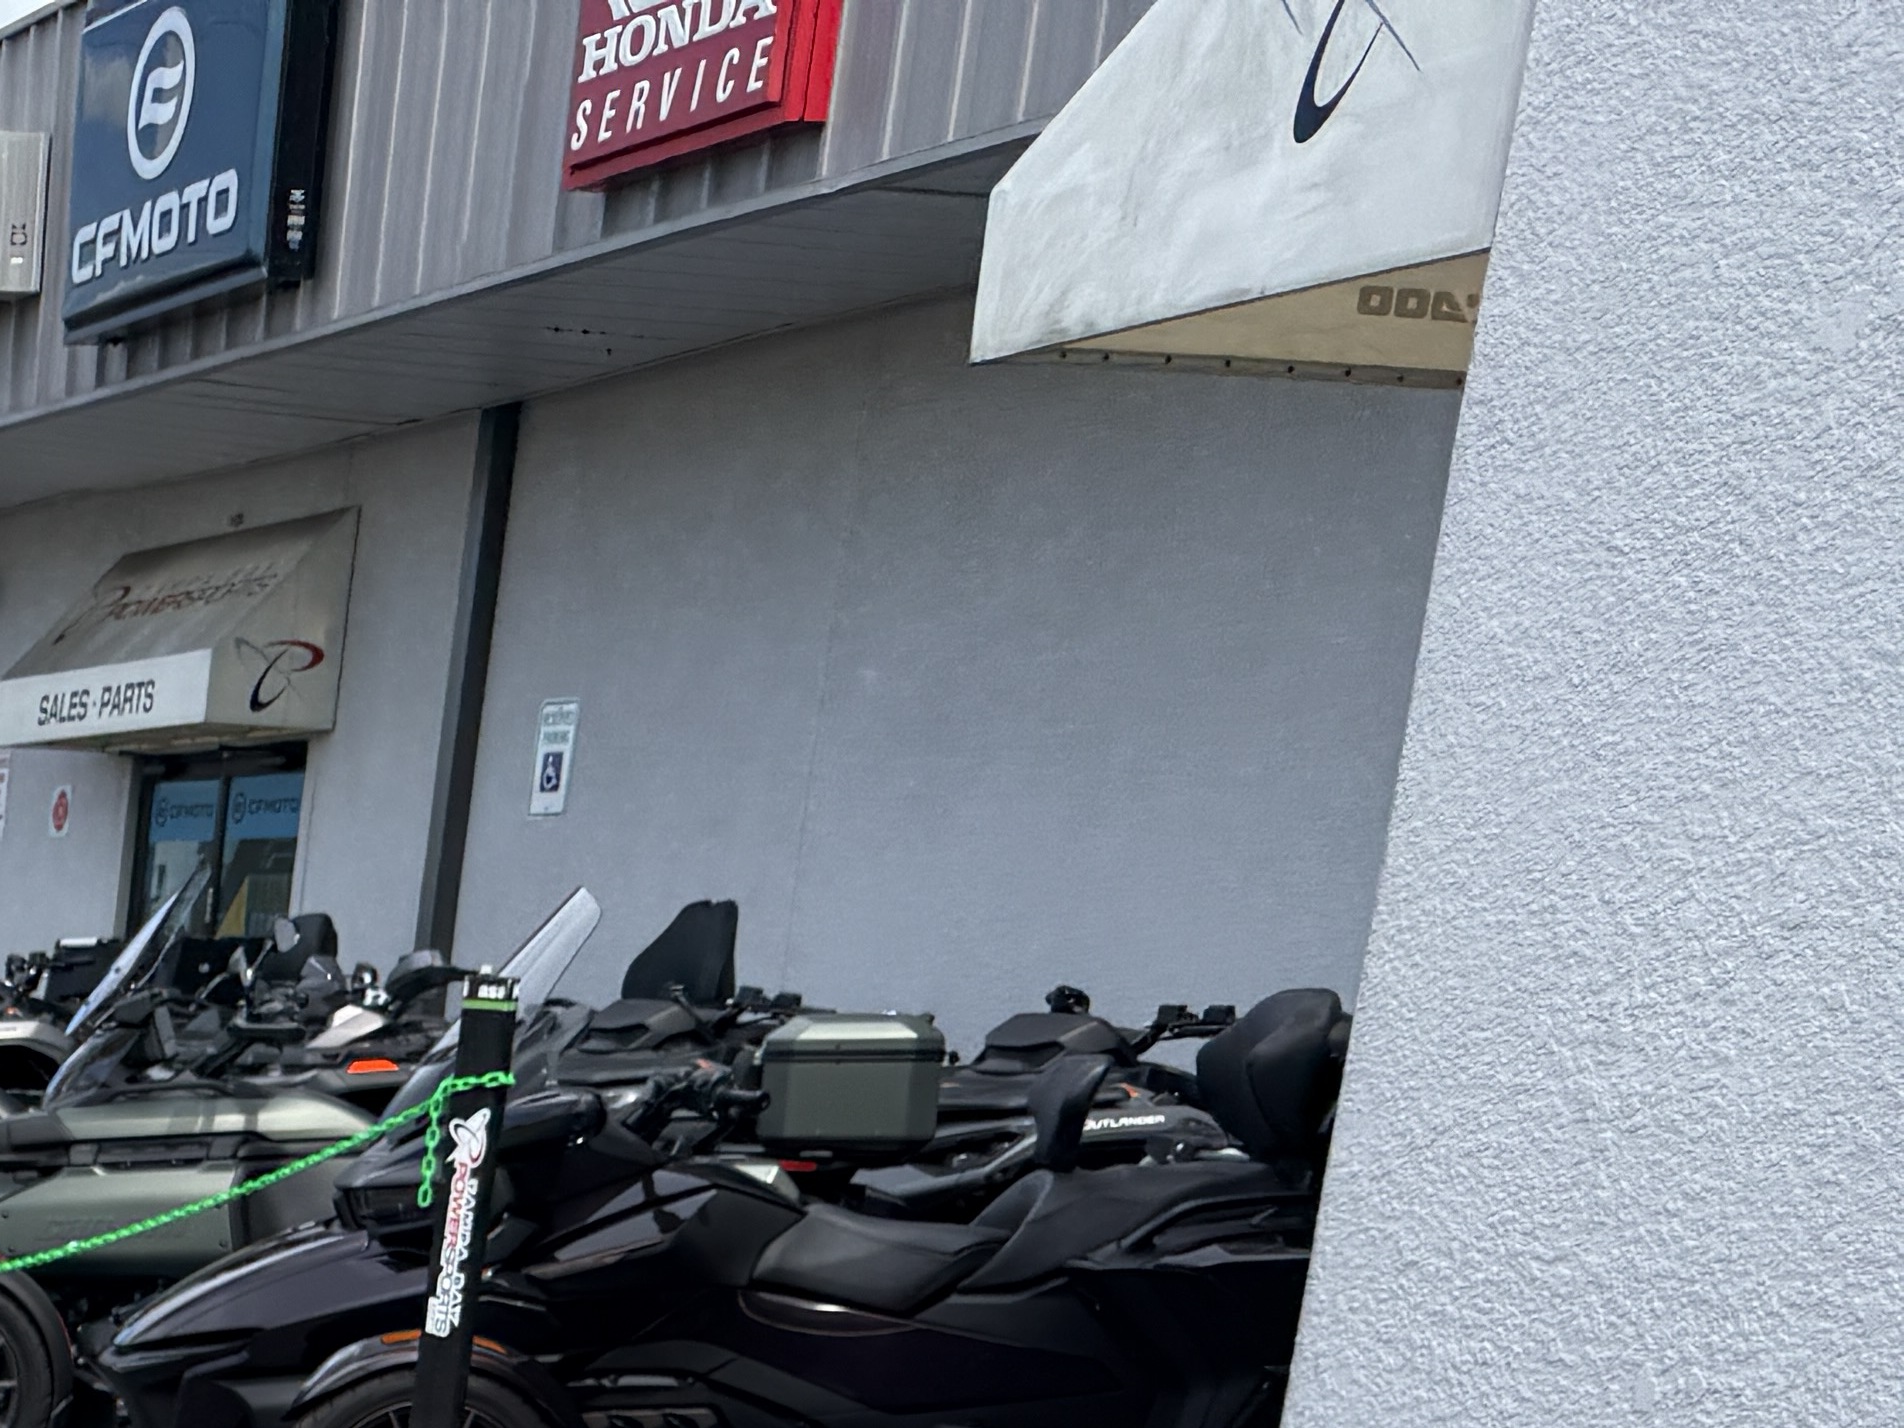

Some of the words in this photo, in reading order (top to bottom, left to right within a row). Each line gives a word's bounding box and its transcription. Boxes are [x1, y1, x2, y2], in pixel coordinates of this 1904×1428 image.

[571, 36, 774, 151] SERVICE
[72, 168, 239, 285] CFMOTO
[37, 688, 90, 727] SALES
[98, 679, 156, 719] PARTS
[434, 1162, 468, 1336] POWERSPORTS
